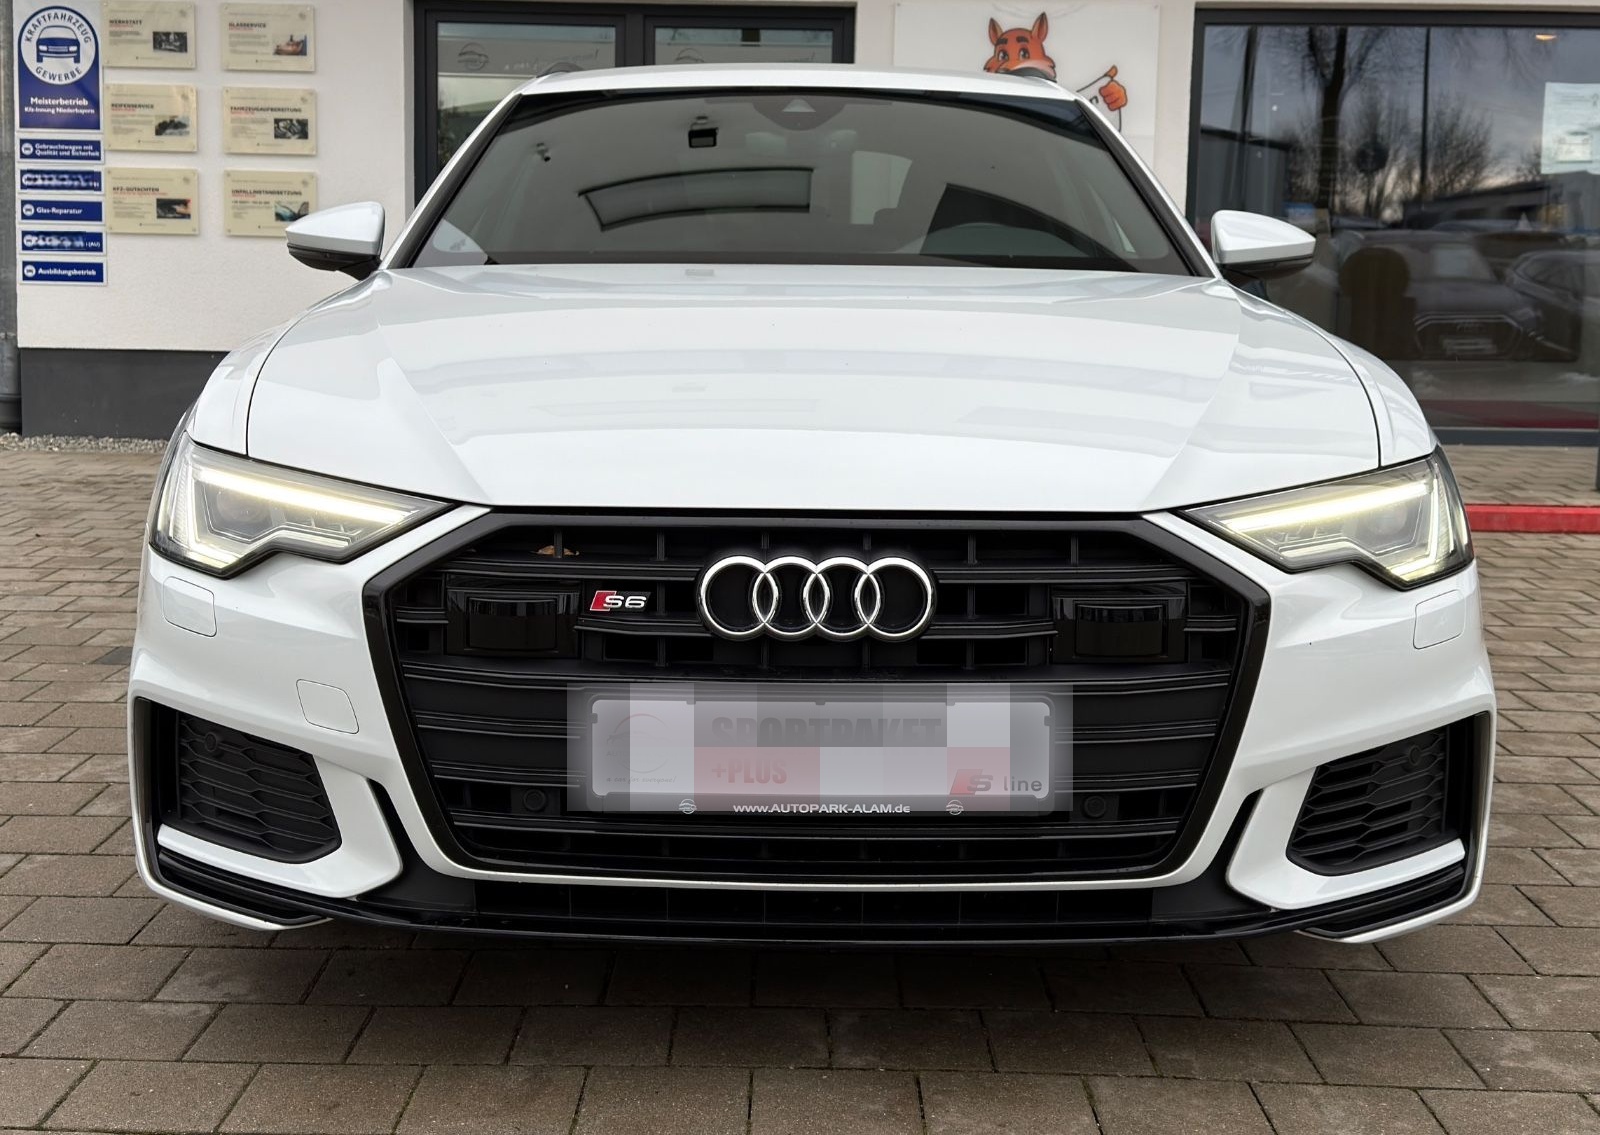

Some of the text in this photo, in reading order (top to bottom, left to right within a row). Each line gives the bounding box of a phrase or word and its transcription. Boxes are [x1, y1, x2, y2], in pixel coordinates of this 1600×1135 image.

[25, 12, 92, 44] KRAFTFAHRZEUG
[35, 66, 82, 82] GEWERBE
[30, 97, 88, 106] Meisterbetrieb
[35, 143, 82, 151] Gebrauchtwagen
[36, 206, 82, 216] Glas-Reparatur
[38, 265, 96, 276] Ausbildungsbetrieb
[603, 595, 647, 609] S6
[711, 758, 787, 785] +PLUS
[1003, 775, 1043, 792] line
[733, 803, 911, 814] www.AUTOPARK-ALAM.de
